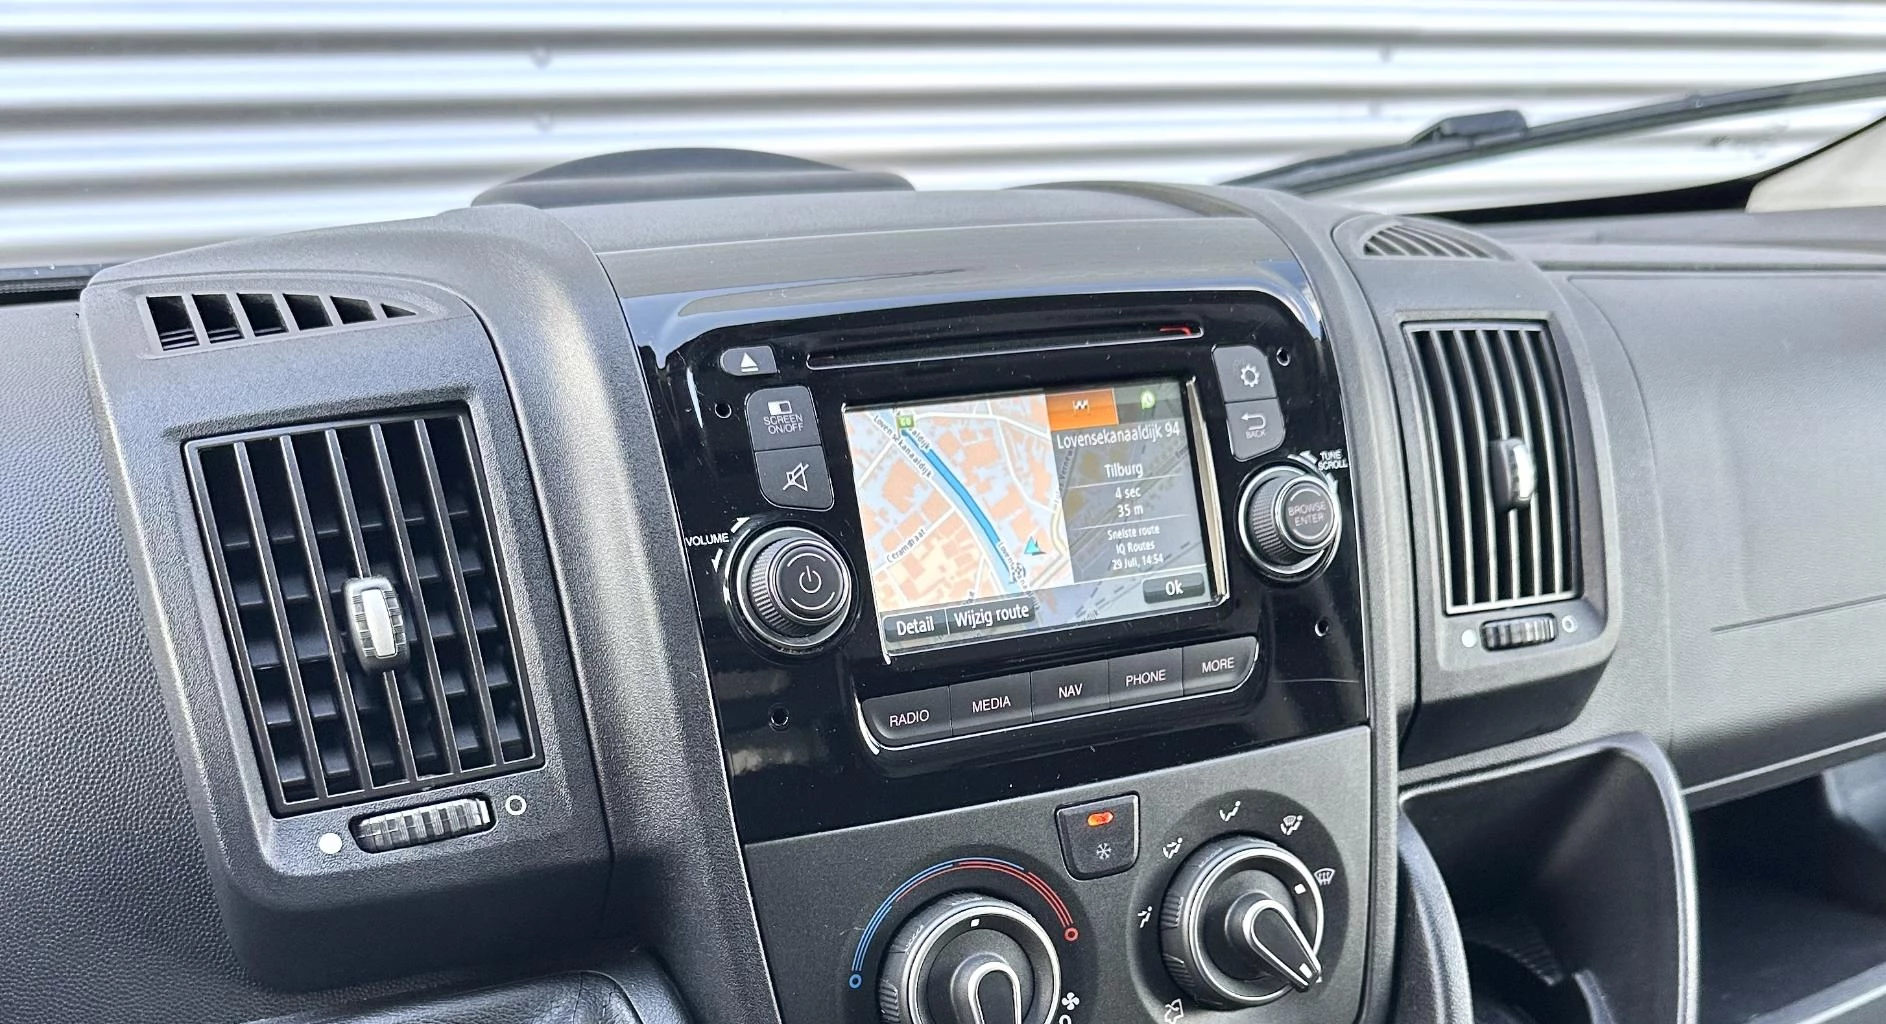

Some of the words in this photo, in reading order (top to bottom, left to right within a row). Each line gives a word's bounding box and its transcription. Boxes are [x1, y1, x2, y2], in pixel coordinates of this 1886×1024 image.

[763, 414, 804, 426] SCREEN
[768, 423, 804, 435] ON/OFF
[1056, 425, 1162, 449] Lovensekanaaldijk
[1164, 421, 1180, 437] 94
[1245, 429, 1266, 440] BACK
[1319, 449, 1342, 461] TUNE
[1104, 462, 1144, 479] Tilburg
[1317, 458, 1349, 471] SCROLL
[1115, 487, 1122, 500] 4
[1124, 487, 1141, 498] sec
[1117, 503, 1131, 518] 35
[1134, 504, 1144, 516] m
[1287, 501, 1327, 516] BROWSE
[1294, 513, 1324, 527] ENTER
[1138, 525, 1160, 536] route
[685, 532, 730, 547] VOLUME
[1127, 540, 1156, 553] Routes
[1111, 559, 1122, 570] 29
[1165, 579, 1184, 596] Ok
[953, 607, 993, 629] Wijzig
[996, 603, 1030, 622] route
[896, 615, 935, 636] Detail
[1201, 656, 1235, 673] MORE
[1125, 669, 1167, 687] PHONE
[1058, 683, 1083, 698] NAV
[971, 695, 1011, 713] MEDIA
[889, 709, 930, 728] RADIO
